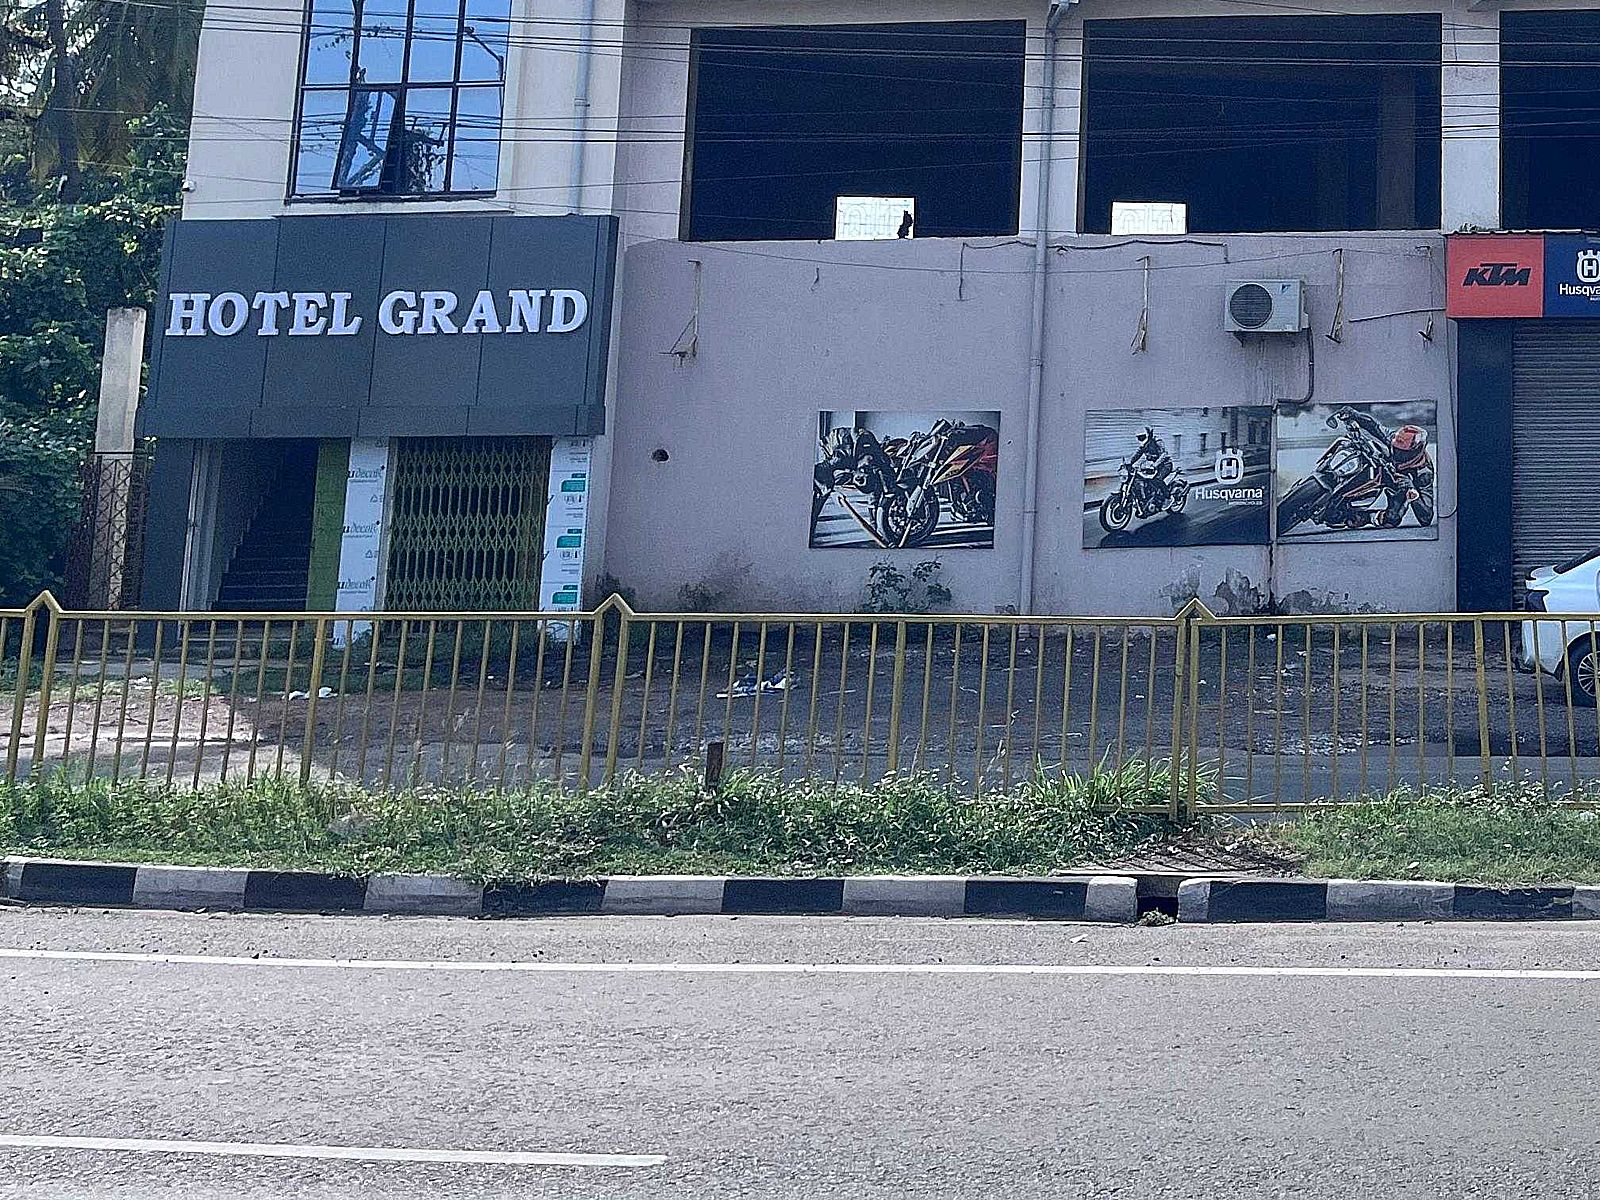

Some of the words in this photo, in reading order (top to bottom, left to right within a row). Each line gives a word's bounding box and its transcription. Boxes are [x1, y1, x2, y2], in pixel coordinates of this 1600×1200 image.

[1462, 263, 1532, 286] KTM
[165, 292, 362, 336] HOTEL
[378, 289, 589, 335] GRAND
[1195, 487, 1263, 500] Husqvarna
